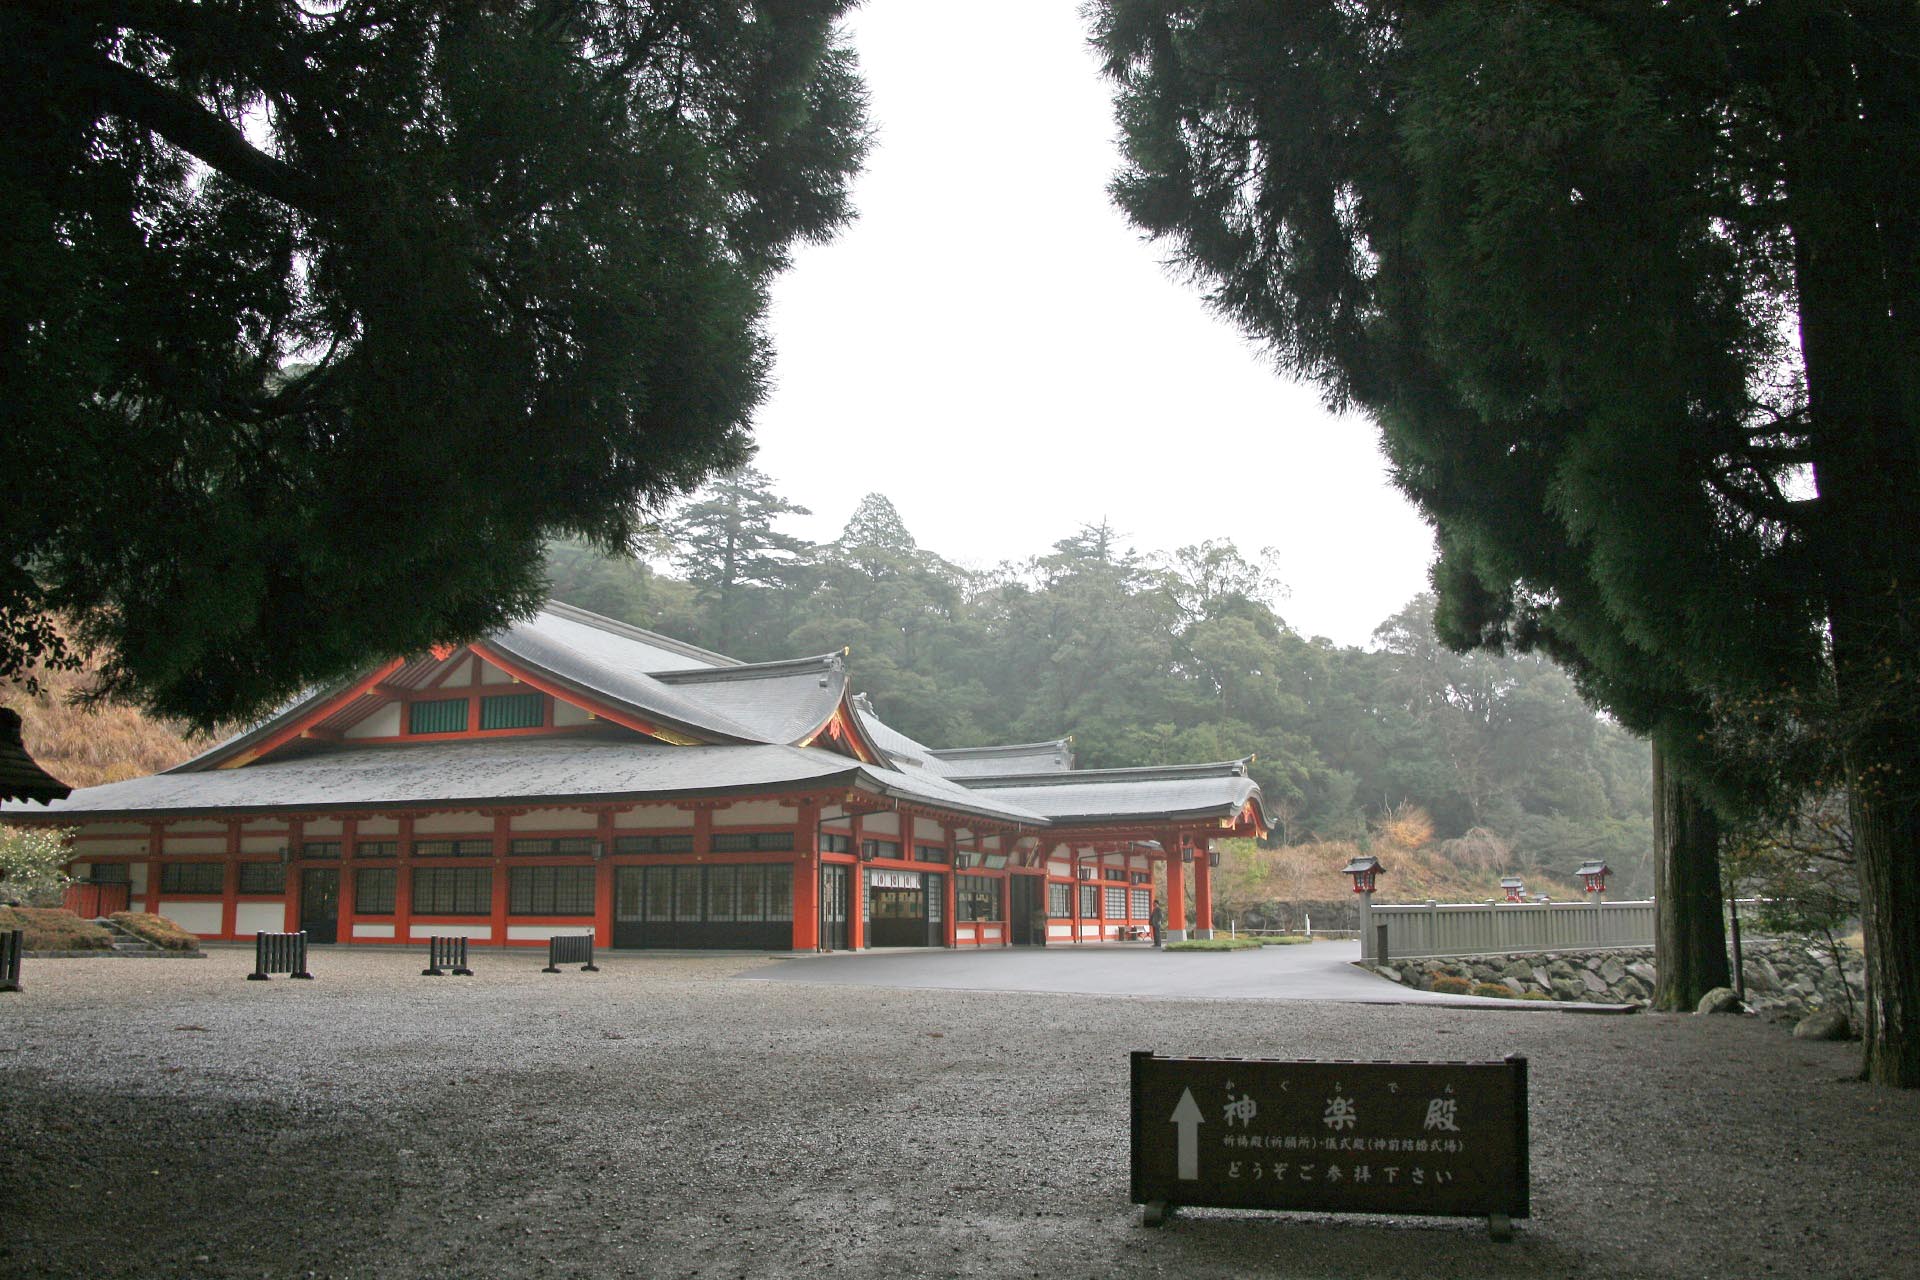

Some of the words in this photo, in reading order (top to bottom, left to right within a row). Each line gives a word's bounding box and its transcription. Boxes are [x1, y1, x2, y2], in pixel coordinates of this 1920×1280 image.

[1223, 1094, 1460, 1131] 神楽殿
[1228, 1161, 1452, 1184] どうぞご参拝下さい
